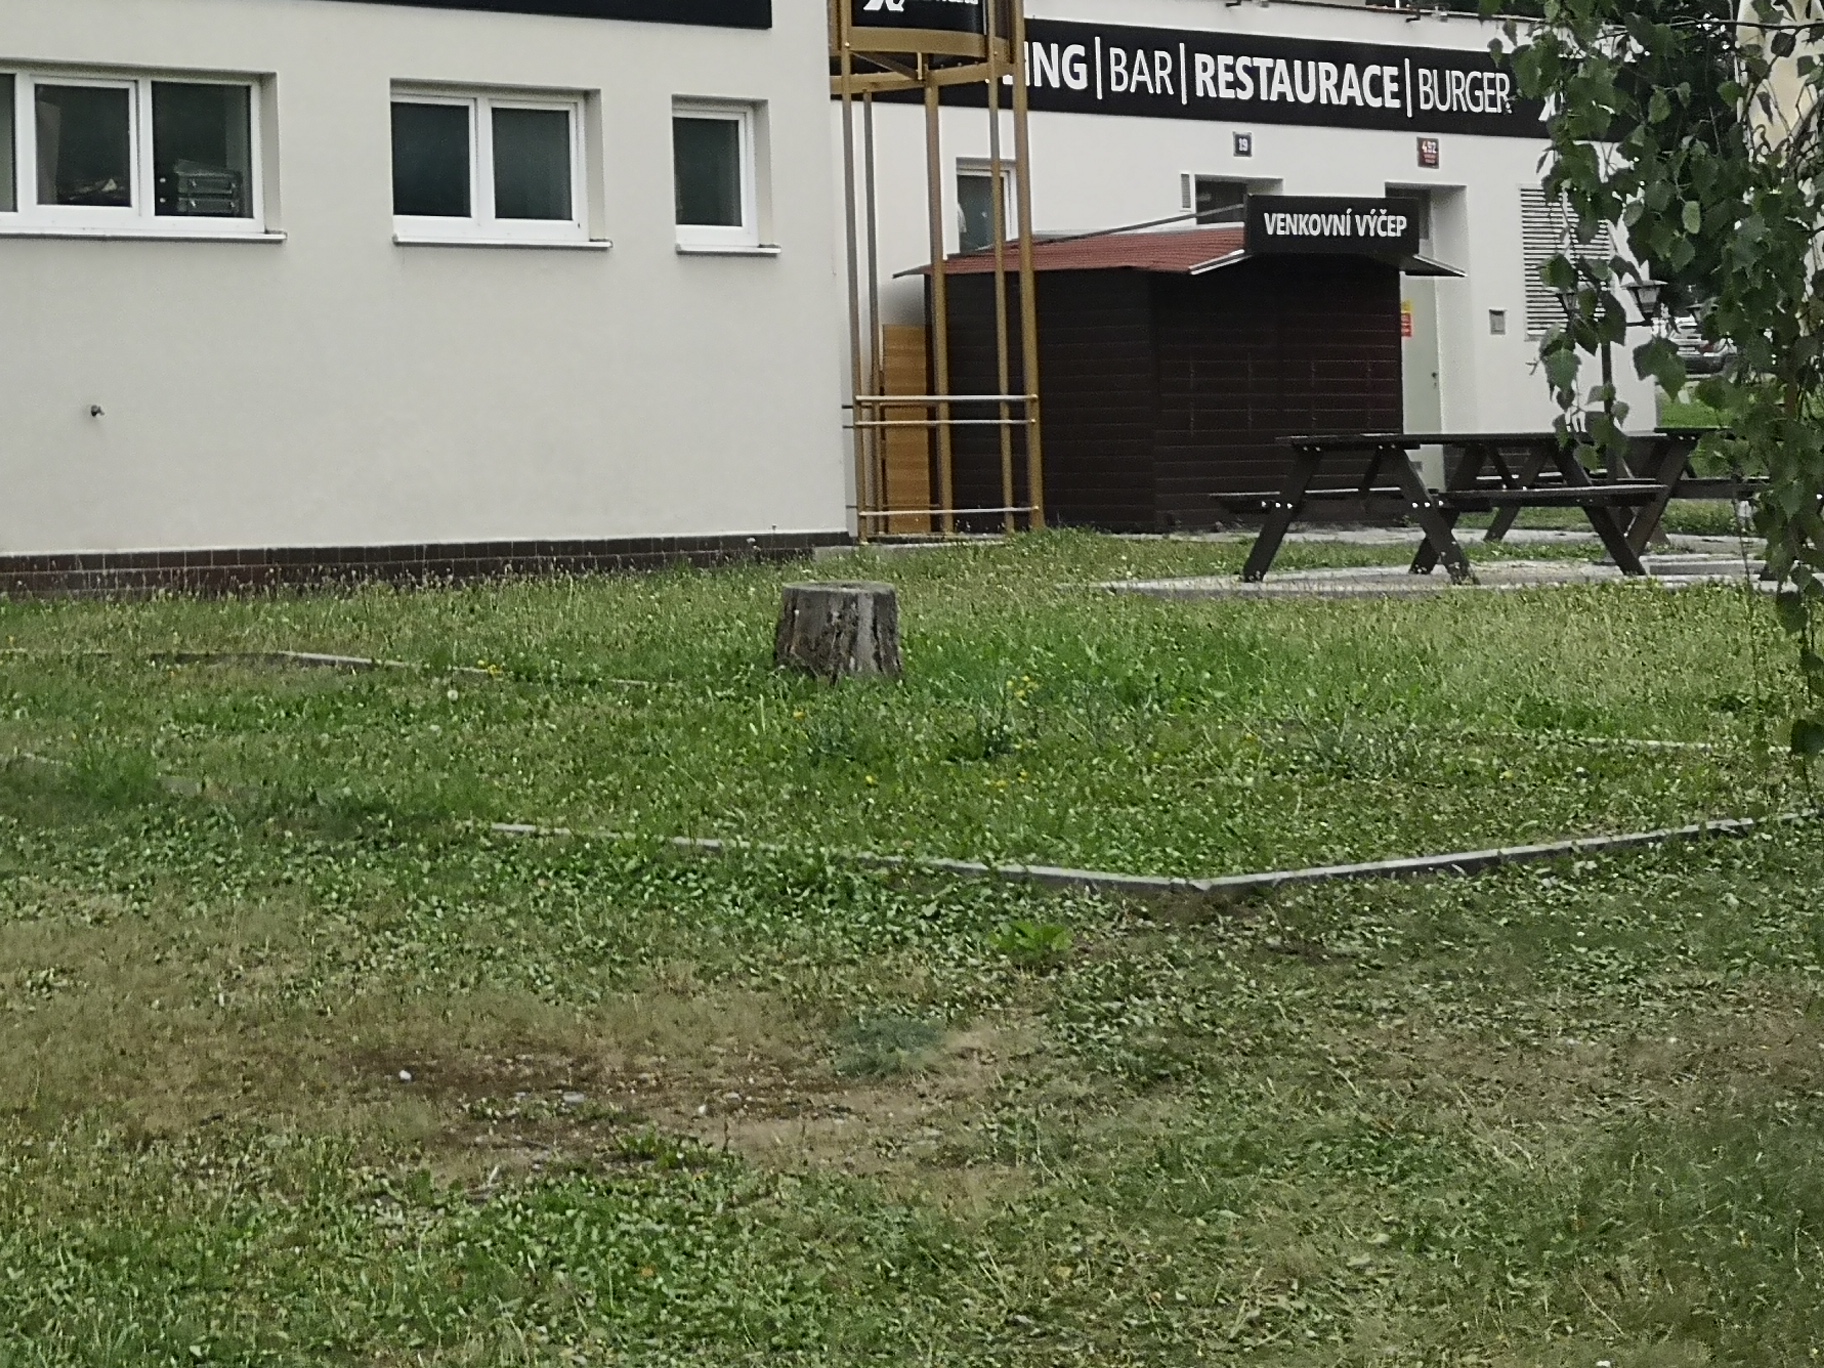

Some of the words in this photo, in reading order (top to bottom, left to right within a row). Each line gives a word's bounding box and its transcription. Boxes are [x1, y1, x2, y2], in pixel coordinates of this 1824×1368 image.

[1109, 46, 1174, 96] BAR
[1195, 53, 1401, 109] RESTAURACE
[1418, 68, 1513, 114] BURGER
[1263, 208, 1353, 237] VENKOVNÍ
[1355, 208, 1407, 238] VÝČEP
